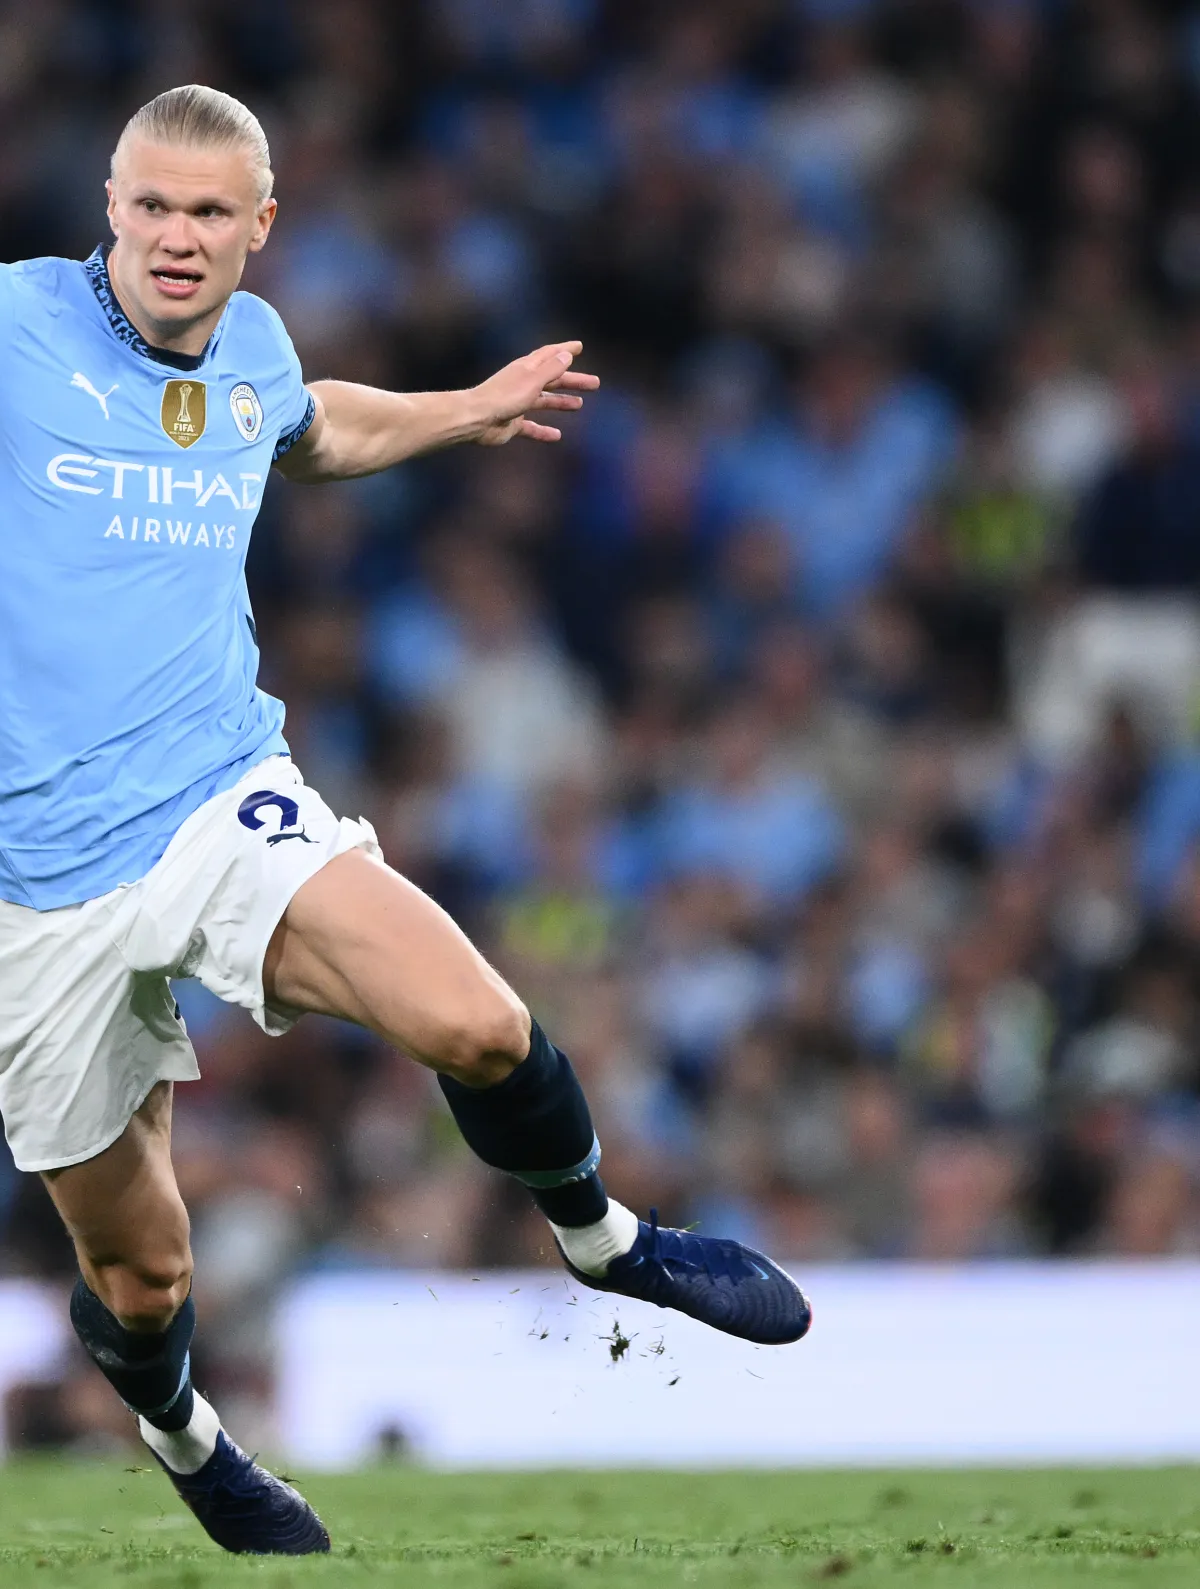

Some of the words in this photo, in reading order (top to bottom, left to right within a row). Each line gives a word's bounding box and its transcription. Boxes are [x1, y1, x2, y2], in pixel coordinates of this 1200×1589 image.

[173, 422, 195, 433] FIFA
[46, 452, 263, 511] ETIHAD
[103, 514, 237, 550] AIRWAYS
